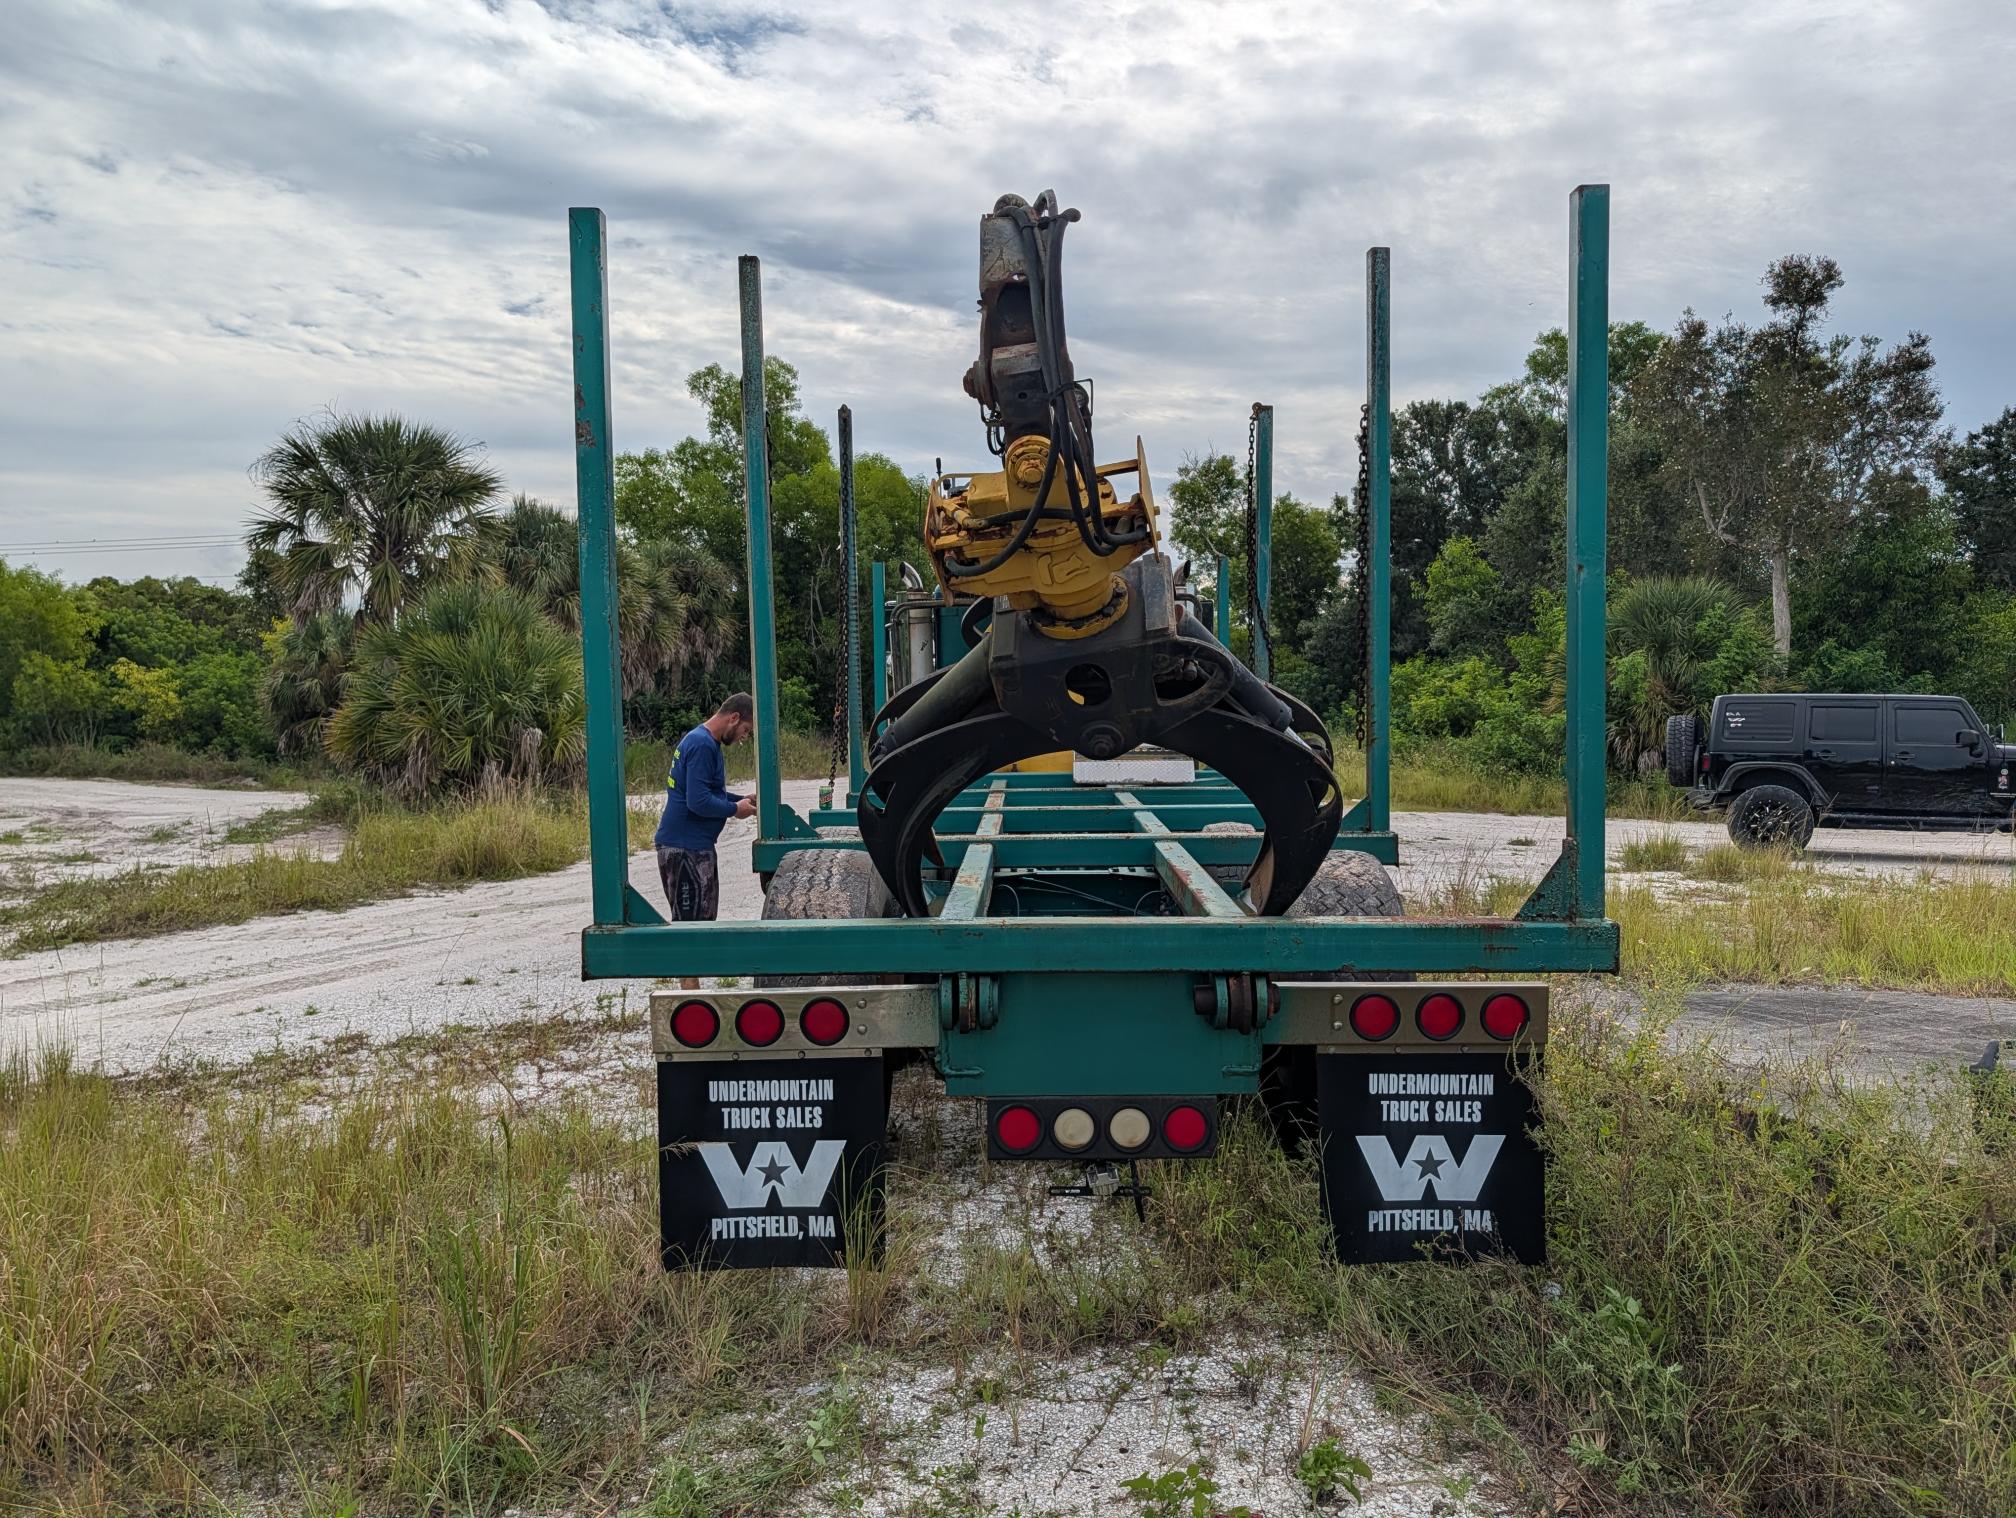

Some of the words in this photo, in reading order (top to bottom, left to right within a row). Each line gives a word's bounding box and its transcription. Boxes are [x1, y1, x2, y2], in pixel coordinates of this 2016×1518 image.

[709, 1079, 834, 1102] UNDERMOUNTAIN
[1369, 1073, 1494, 1095] UNDERMOUNTAIN
[722, 1107, 771, 1129] TRUCK
[776, 1106, 823, 1128] SALES
[1380, 1100, 1429, 1122] TRUCK
[1435, 1100, 1482, 1122] SALES
[711, 1216, 804, 1240] PITTSFIELD,
[808, 1215, 836, 1238] MA
[1368, 1209, 1459, 1233] PITTSFIELD,
[1464, 1209, 1493, 1231] MA
